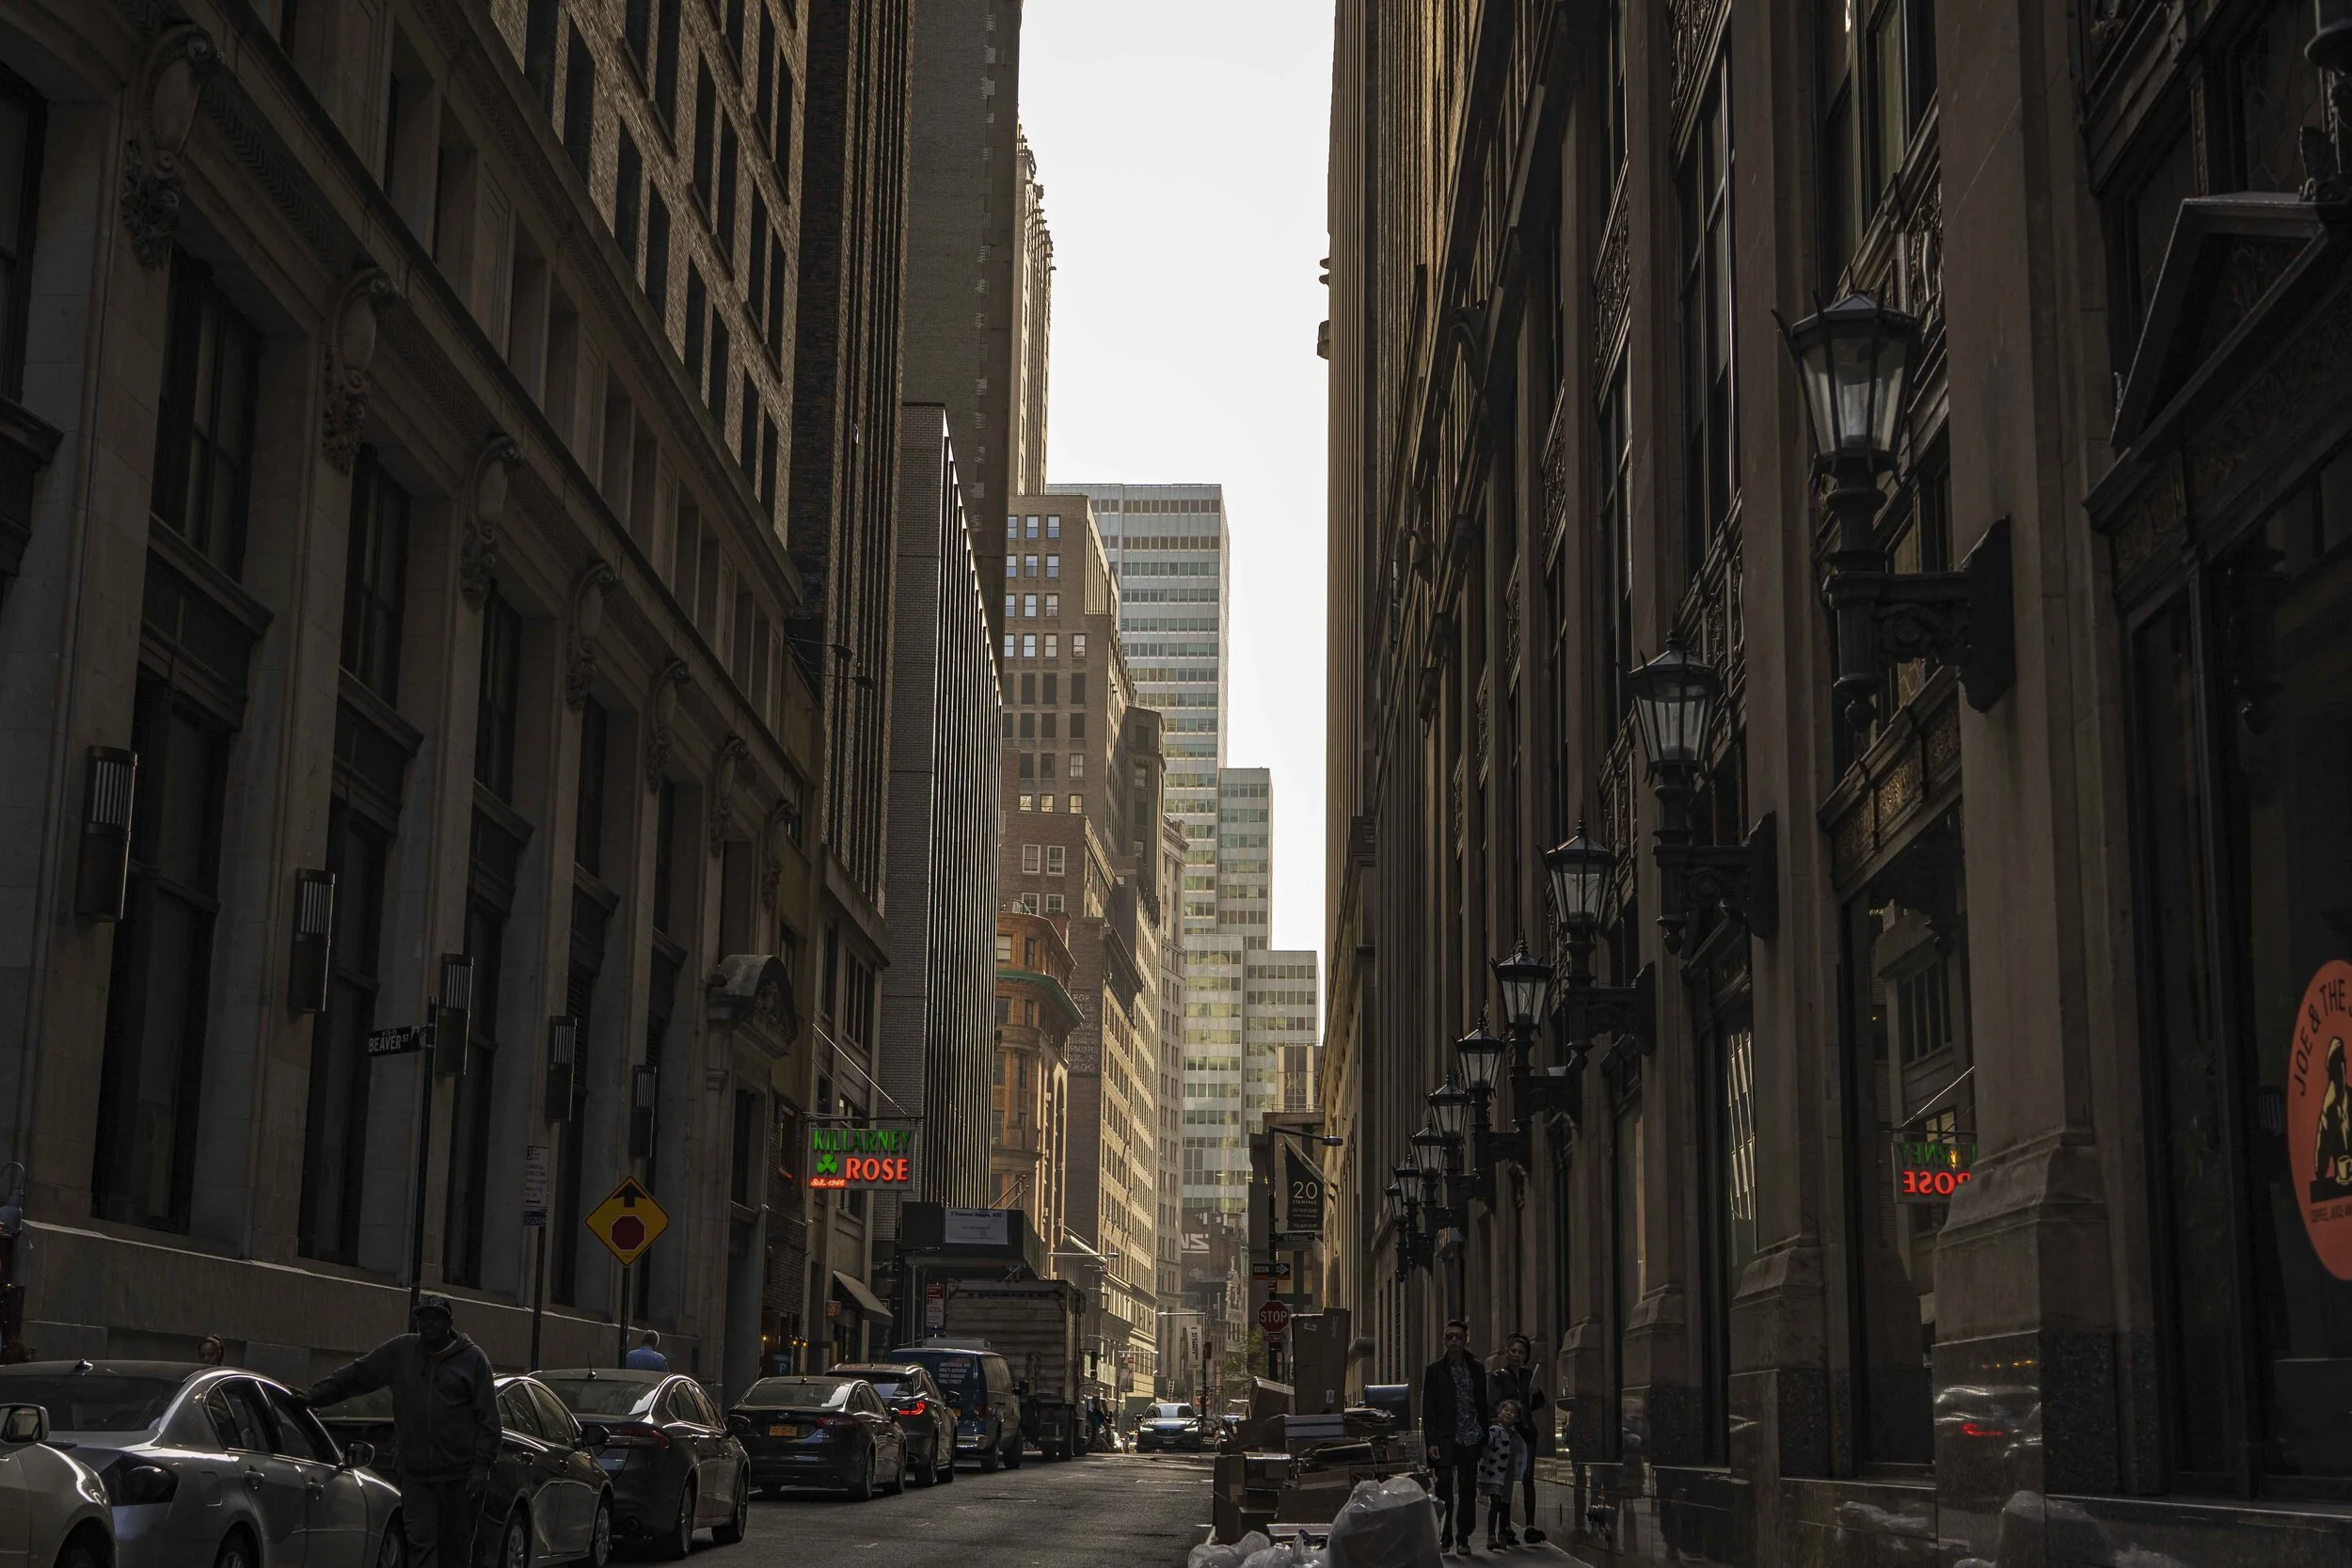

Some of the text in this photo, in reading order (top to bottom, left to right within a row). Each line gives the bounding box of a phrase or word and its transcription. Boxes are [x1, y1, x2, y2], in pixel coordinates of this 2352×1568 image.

[368, 1034, 410, 1053] BEAVER ST
[2294, 978, 2345, 1097] JOE & THE
[813, 1129, 911, 1152] KILLARNEY
[845, 1157, 909, 1181] ROSE
[1293, 1181, 1317, 1199] 20
[1260, 1310, 1288, 1323] STOP
